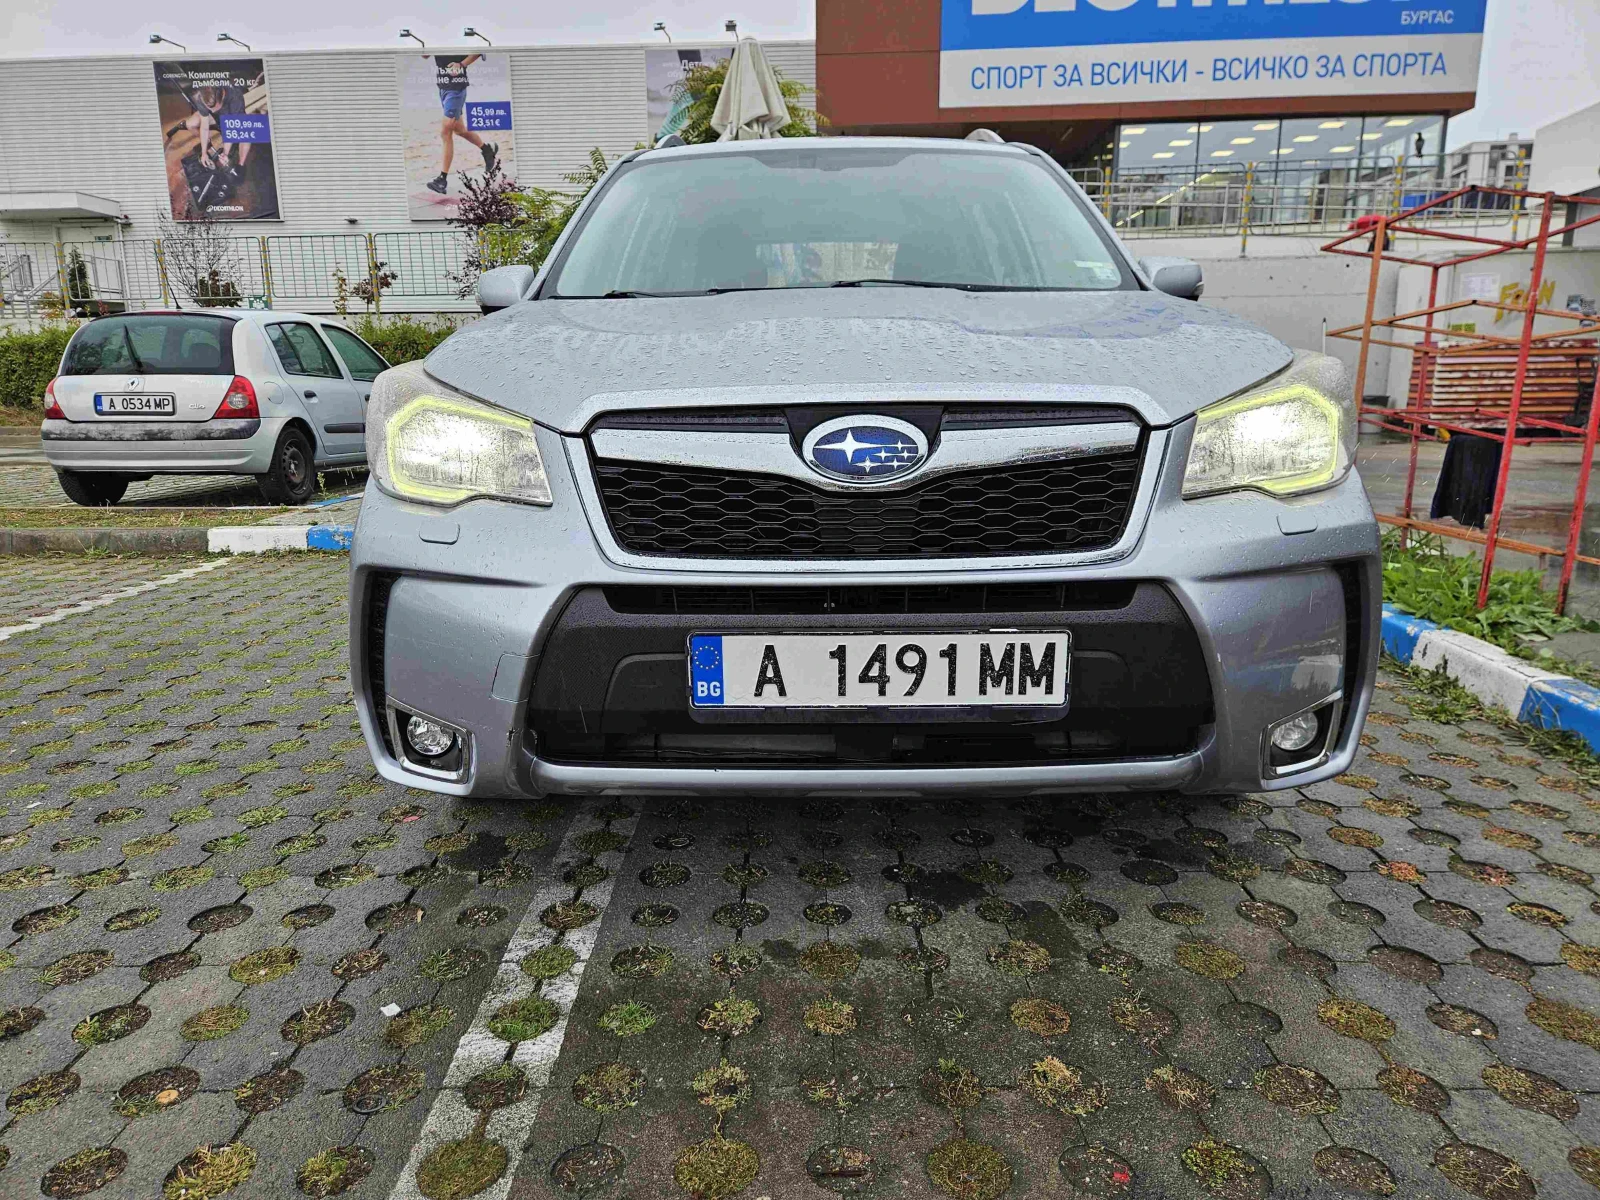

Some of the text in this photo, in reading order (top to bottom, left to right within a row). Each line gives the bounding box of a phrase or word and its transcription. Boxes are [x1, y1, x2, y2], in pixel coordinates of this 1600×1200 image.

[1401, 10, 1454, 25] БУРГАС
[188, 71, 230, 79] Комплект
[971, 65, 1047, 90] СПОРТ
[1053, 64, 1083, 87] ЗА
[1090, 59, 1188, 86] ВСИЧКИ
[1212, 55, 1308, 81] ВСИЧКО
[1315, 54, 1346, 78] ЗА
[1353, 52, 1447, 77] СПОРТА
[192, 79, 233, 88] дъмбели,
[234, 78, 245, 86] 20
[470, 106, 495, 117] 45,99
[224, 119, 252, 129] 109,99
[471, 117, 494, 127] 23,51
[226, 130, 249, 139] 56,24
[109, 397, 170, 410] A 0534 MP
[754, 642, 1057, 697] A 1491 MM
[697, 681, 721, 697] BG
